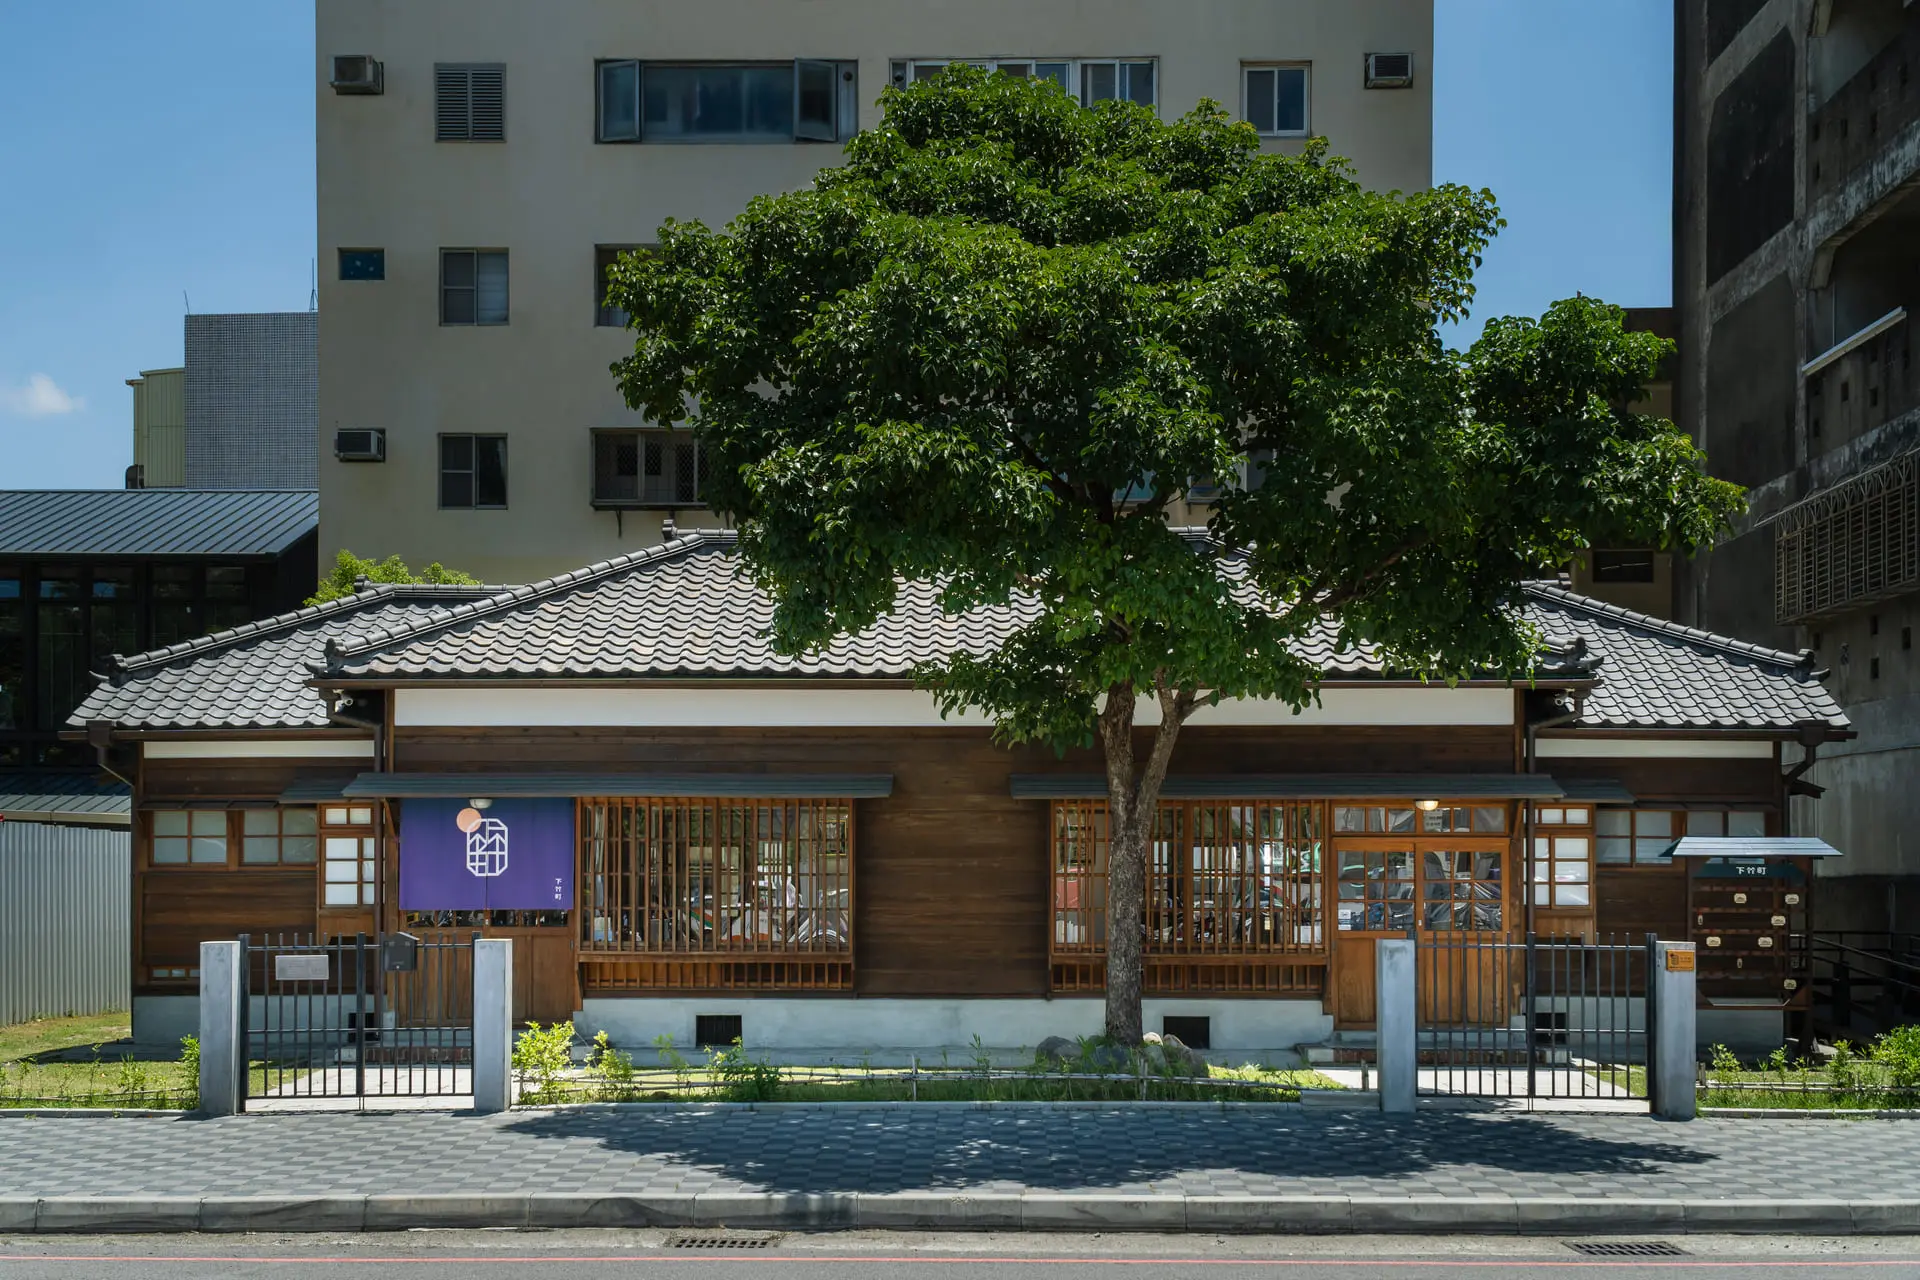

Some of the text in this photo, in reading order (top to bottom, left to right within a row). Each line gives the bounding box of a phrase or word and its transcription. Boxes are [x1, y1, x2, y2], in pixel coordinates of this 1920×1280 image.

[1736, 866, 1767, 875] 下竹町
[554, 878, 563, 901] 下竹町
